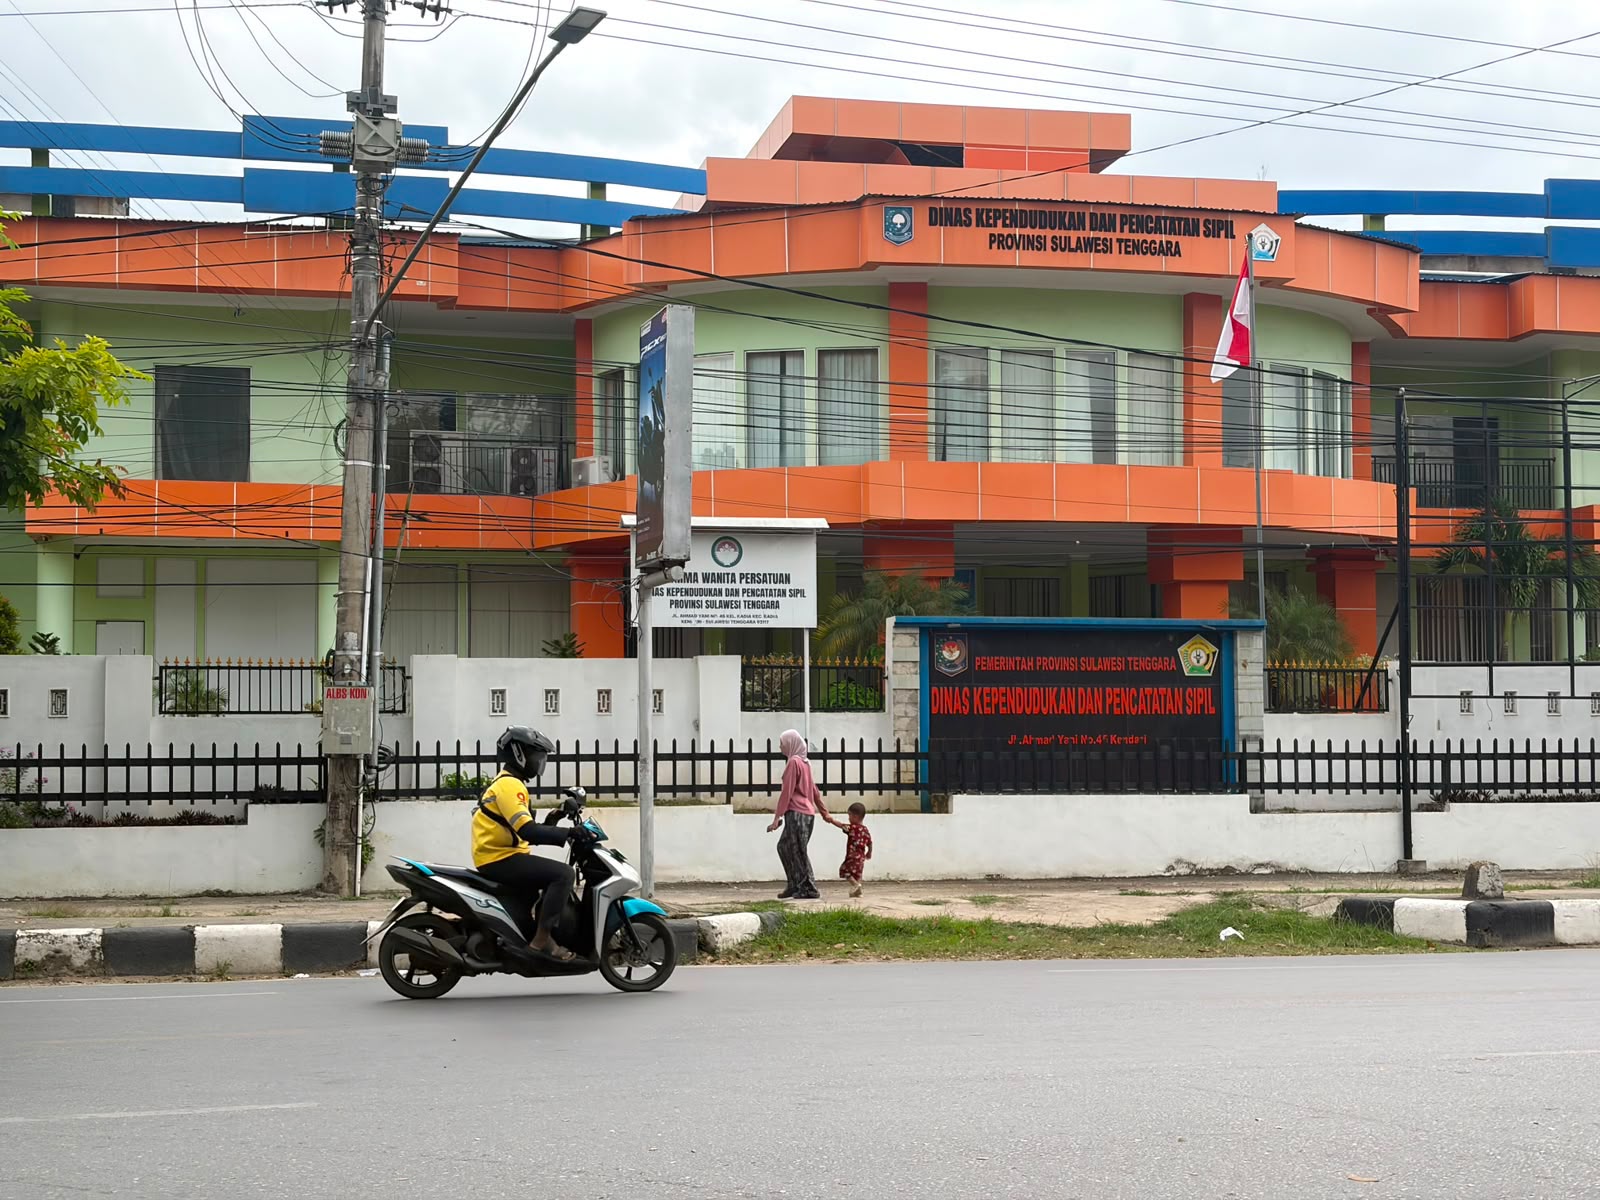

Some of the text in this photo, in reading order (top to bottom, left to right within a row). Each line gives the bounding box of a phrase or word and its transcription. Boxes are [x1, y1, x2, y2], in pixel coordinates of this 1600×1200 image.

[928, 206, 1236, 240] DINAS KEPENDUDUKAN DAN PENCATATAN SIPIL
[988, 232, 1182, 258] PROVINSI SULAWESI TENGGARA
[701, 571, 737, 585] WANITA
[739, 572, 791, 585] PERSATUAN
[666, 587, 723, 598] KEPENDUDUKAN
[724, 587, 740, 598] DAN
[741, 588, 787, 598] PENCATATAN
[788, 588, 807, 598] SIPIL
[669, 599, 780, 610] PROVINSI SULAWESI TENGGARA
[975, 656, 1177, 671] PEMERINTAH PROVINSI SULAWESI TENGGARA
[326, 688, 347, 699] ALBS
[931, 686, 1216, 715] DINAS KEPENDUDUKAN DAN PENCATATAN SIPIL
